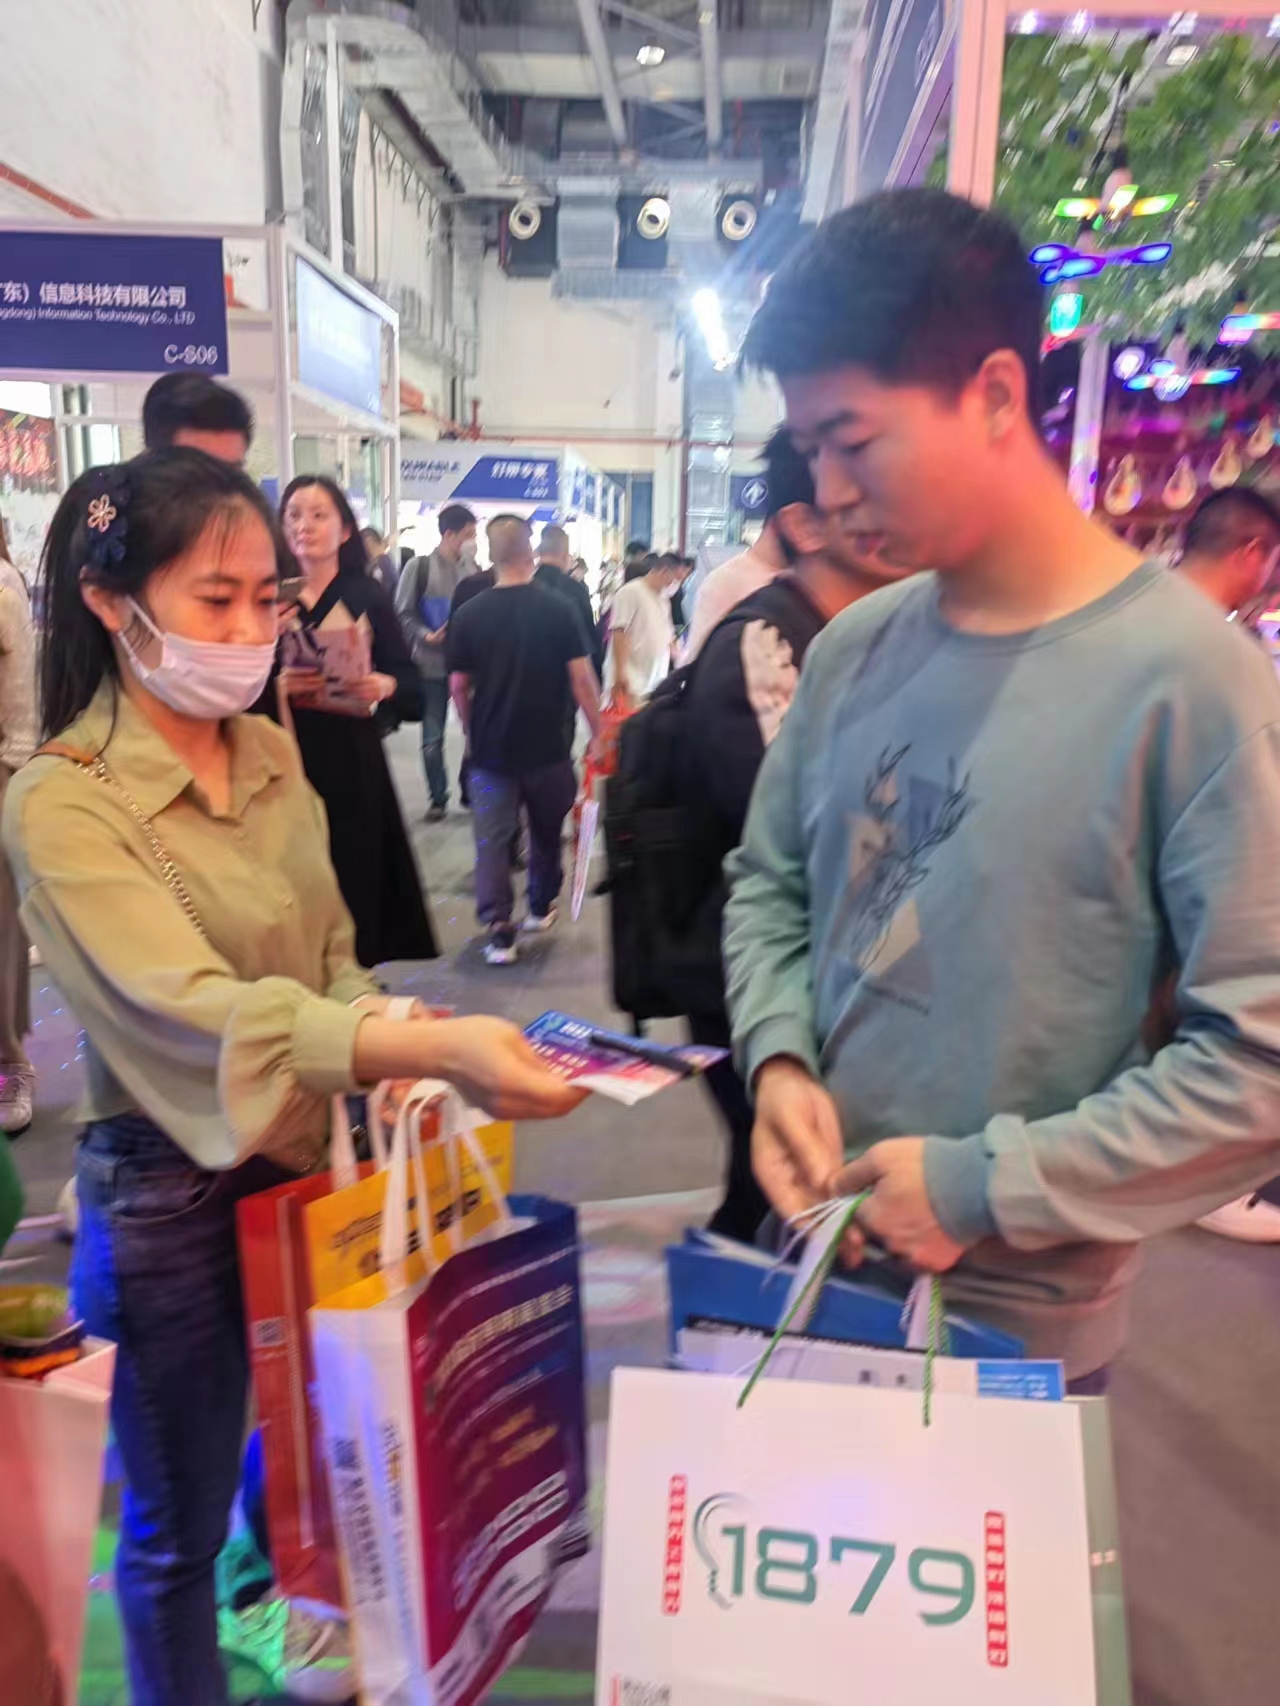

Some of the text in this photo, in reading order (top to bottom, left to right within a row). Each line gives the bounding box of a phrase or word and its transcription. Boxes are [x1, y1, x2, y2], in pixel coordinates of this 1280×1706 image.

[38, 307, 93, 321] Information
[94, 308, 150, 326] Technology
[720, 1524, 977, 1628] 1879
